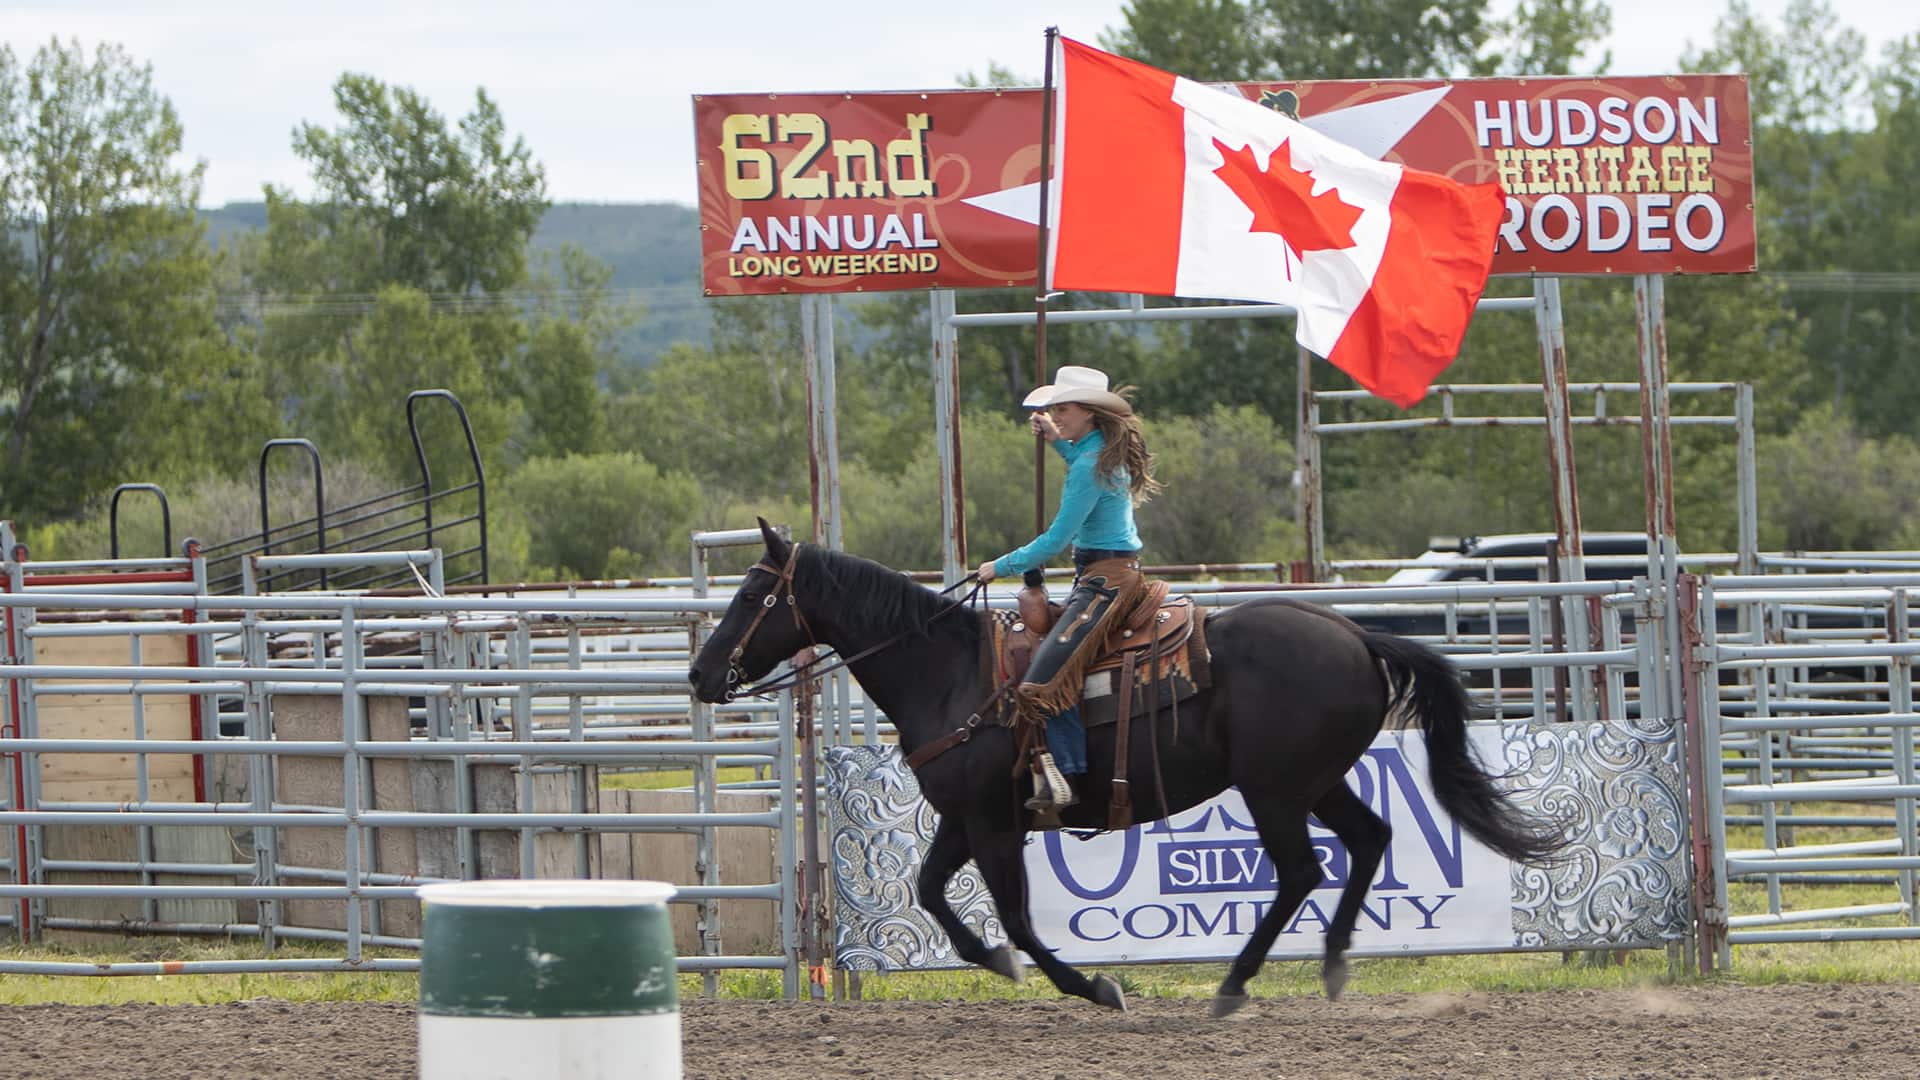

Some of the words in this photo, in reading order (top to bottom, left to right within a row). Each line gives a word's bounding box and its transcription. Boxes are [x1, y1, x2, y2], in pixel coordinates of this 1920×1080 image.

[1474, 97, 1719, 147] HUDSON
[718, 113, 936, 200] 62nd
[1495, 146, 1715, 194] HERITAGE
[730, 213, 939, 252] ANNUAL
[1495, 193, 1725, 252] RODEO
[729, 255, 801, 277] LONG
[807, 253, 939, 275] WEEKEND
[1169, 845, 1339, 886] SILVR
